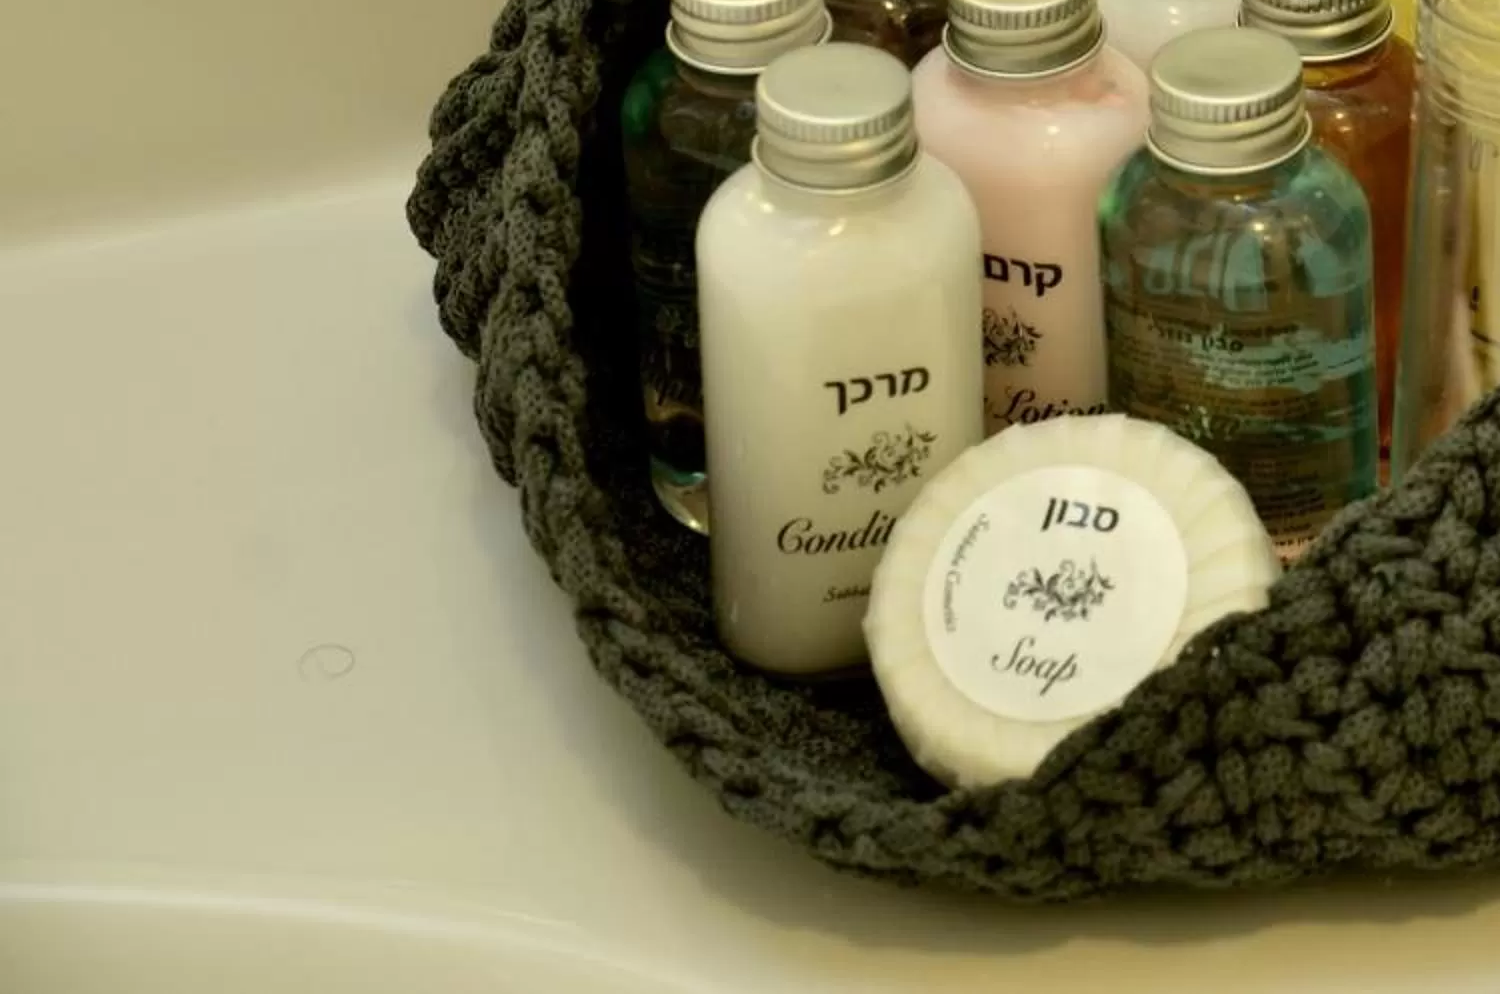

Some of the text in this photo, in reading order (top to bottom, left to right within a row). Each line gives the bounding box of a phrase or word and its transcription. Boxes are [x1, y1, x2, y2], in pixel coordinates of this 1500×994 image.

[983, 252, 1063, 298] קרם
[824, 367, 931, 415] מרכך
[777, 509, 898, 555] Condit
[1041, 495, 1120, 532] סבון
[991, 636, 1079, 696] Soap
